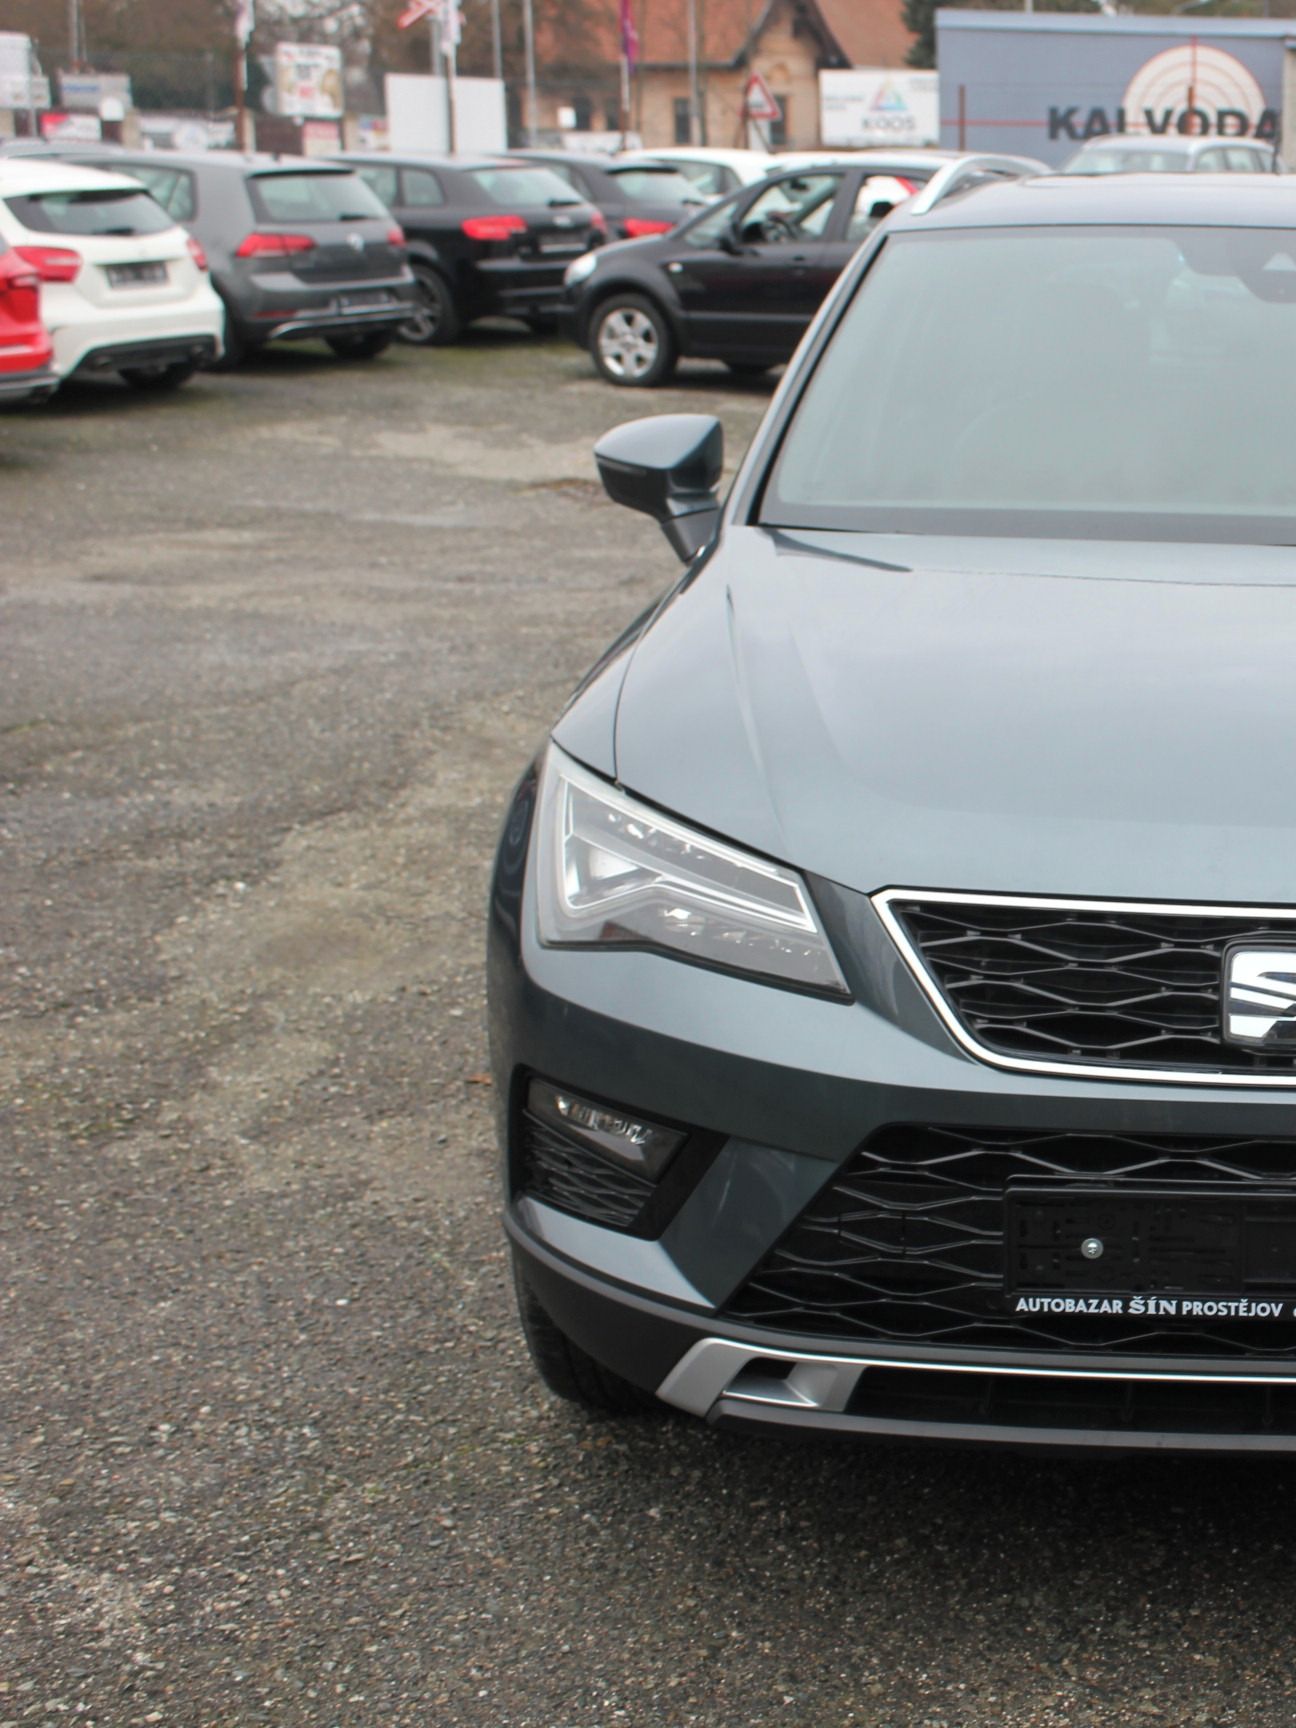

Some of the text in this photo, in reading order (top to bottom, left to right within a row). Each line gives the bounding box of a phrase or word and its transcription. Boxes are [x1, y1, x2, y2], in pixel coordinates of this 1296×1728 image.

[1015, 1297, 1123, 1314] AUTOBAZAR
[1127, 1295, 1178, 1315] ŠÍN
[1181, 1298, 1284, 1317] PROSTĚJOV
